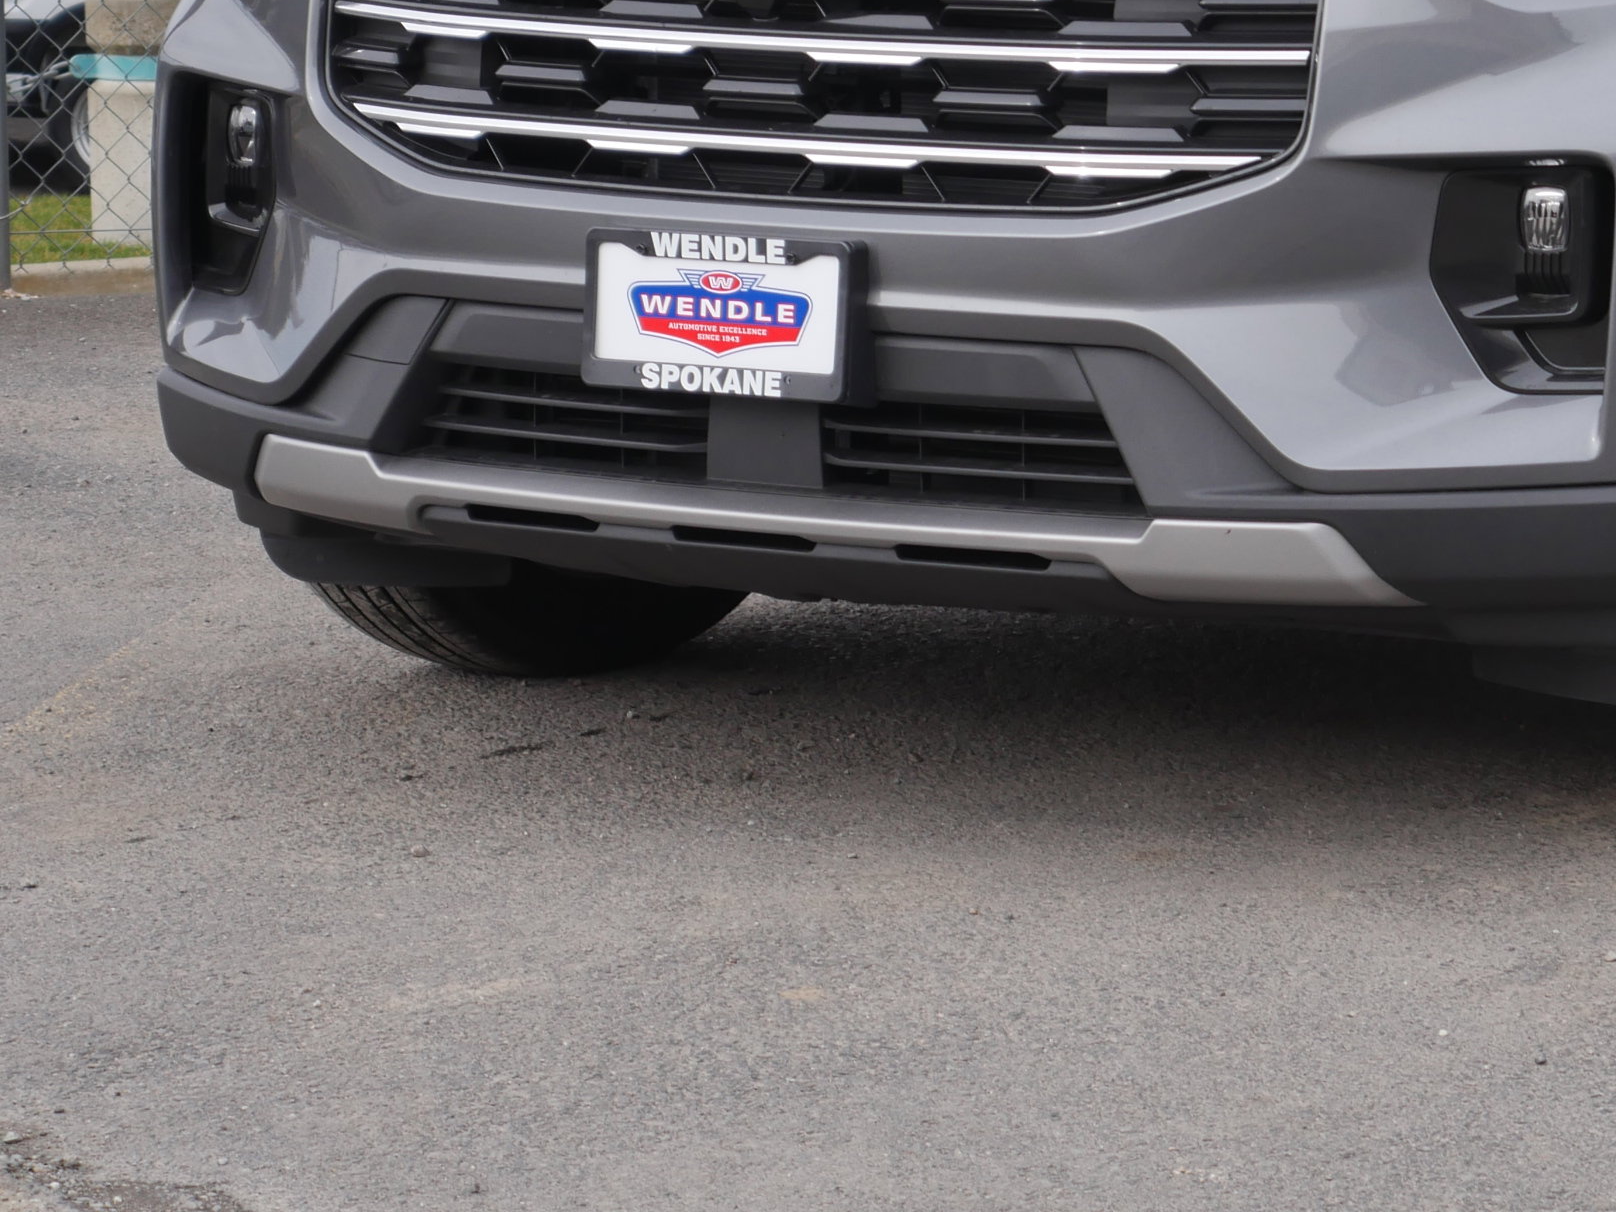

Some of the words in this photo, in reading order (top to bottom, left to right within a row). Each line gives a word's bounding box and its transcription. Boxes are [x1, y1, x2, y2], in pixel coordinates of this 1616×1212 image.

[650, 231, 786, 265] WENDLE
[641, 294, 795, 324] WENDLE
[668, 322, 717, 332] AUTOMOTIVE
[719, 326, 767, 336] EXCELLENCE
[697, 333, 720, 342] SINCE
[722, 335, 740, 343] 1943
[641, 362, 782, 397] SPOKANE
